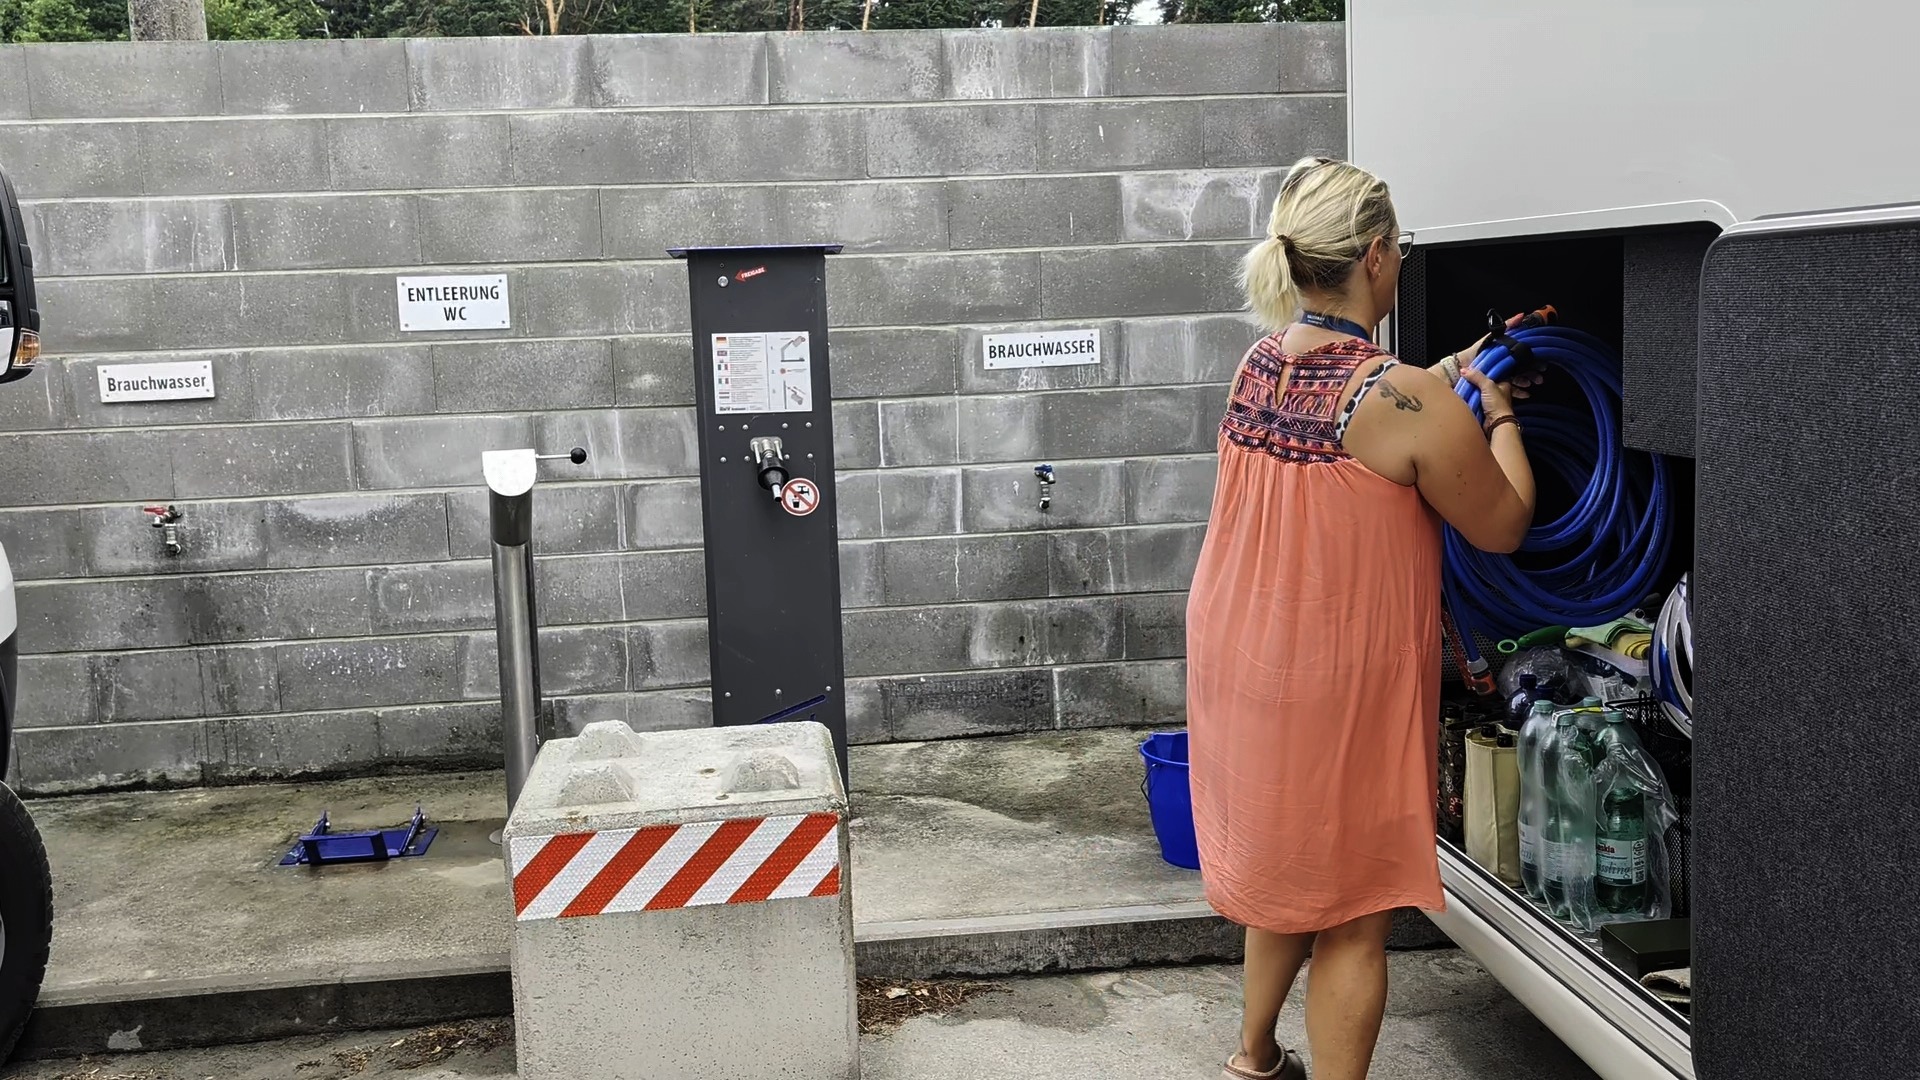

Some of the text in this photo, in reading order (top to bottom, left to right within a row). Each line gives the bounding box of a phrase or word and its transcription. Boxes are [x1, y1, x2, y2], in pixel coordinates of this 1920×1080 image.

[407, 285, 499, 302] ENTLEERUNG
[443, 306, 467, 322] WC
[988, 340, 1095, 359] BRAUCHWASSER
[107, 375, 206, 392] Brauchwasser
